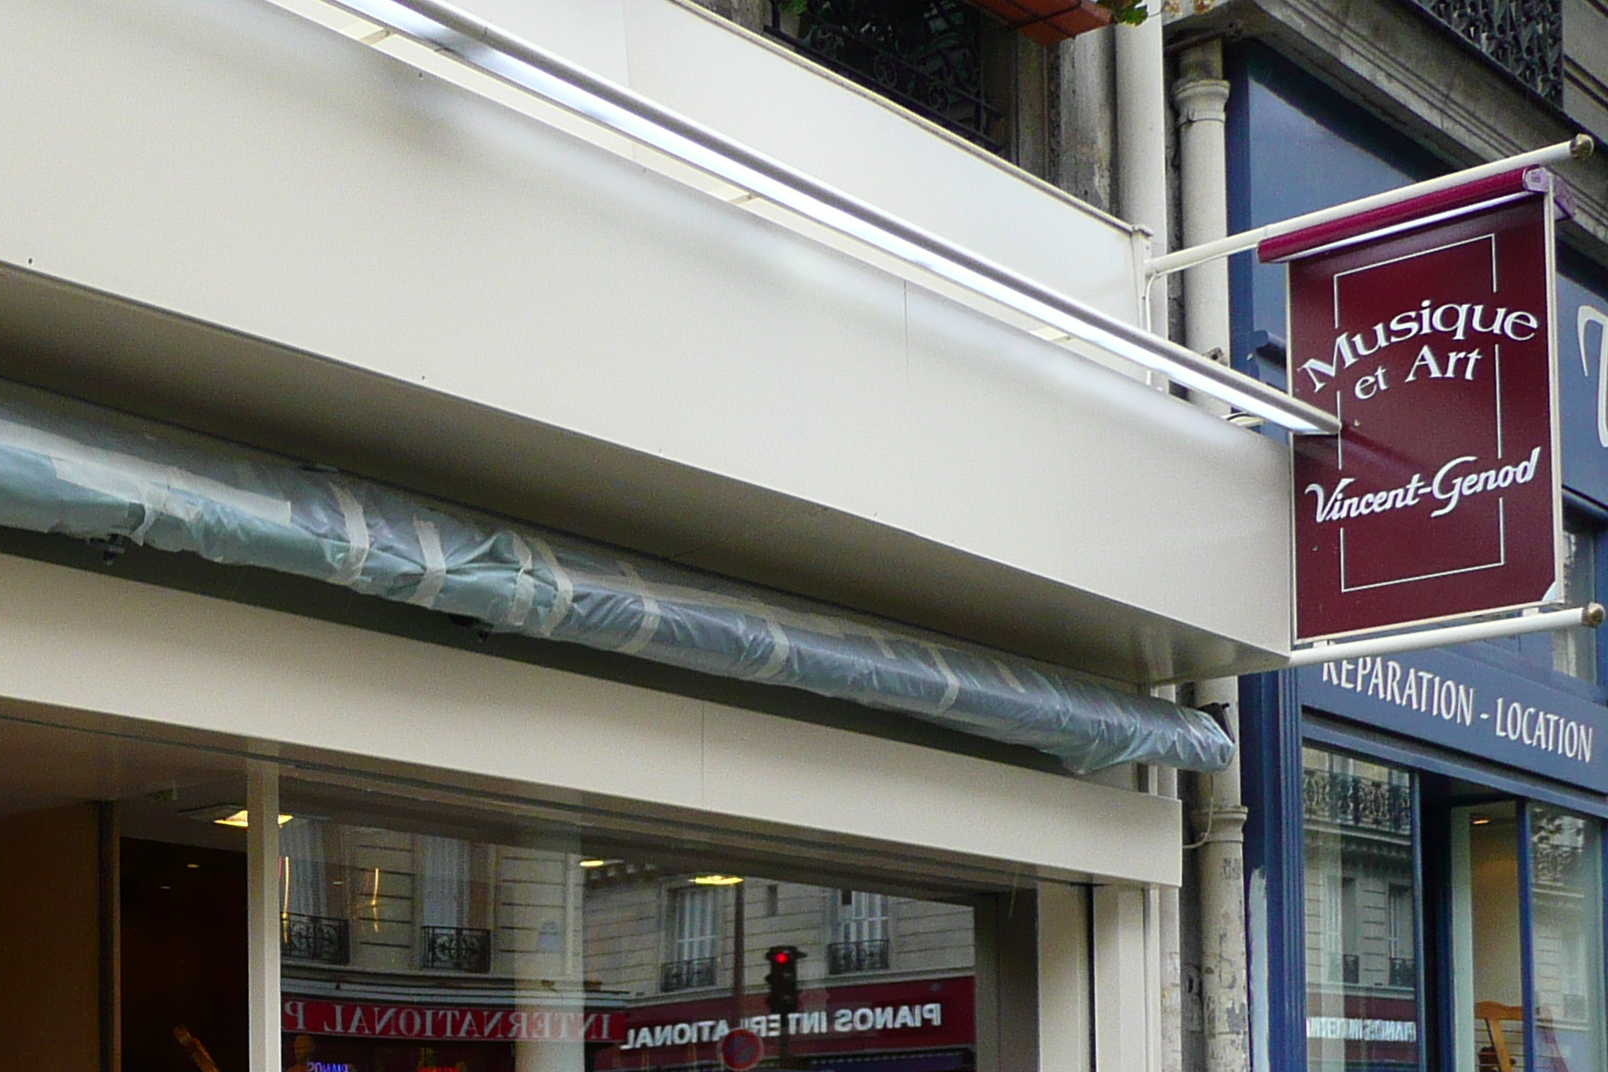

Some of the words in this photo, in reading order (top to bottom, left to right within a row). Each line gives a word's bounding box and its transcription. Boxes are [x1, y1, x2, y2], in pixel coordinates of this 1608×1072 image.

[1299, 299, 1539, 393] Musique
[1354, 365, 1389, 400] et
[1405, 344, 1482, 382] Art
[1305, 446, 1542, 523] Vincent-Genod
[1495, 697, 1593, 763] LOCATION
